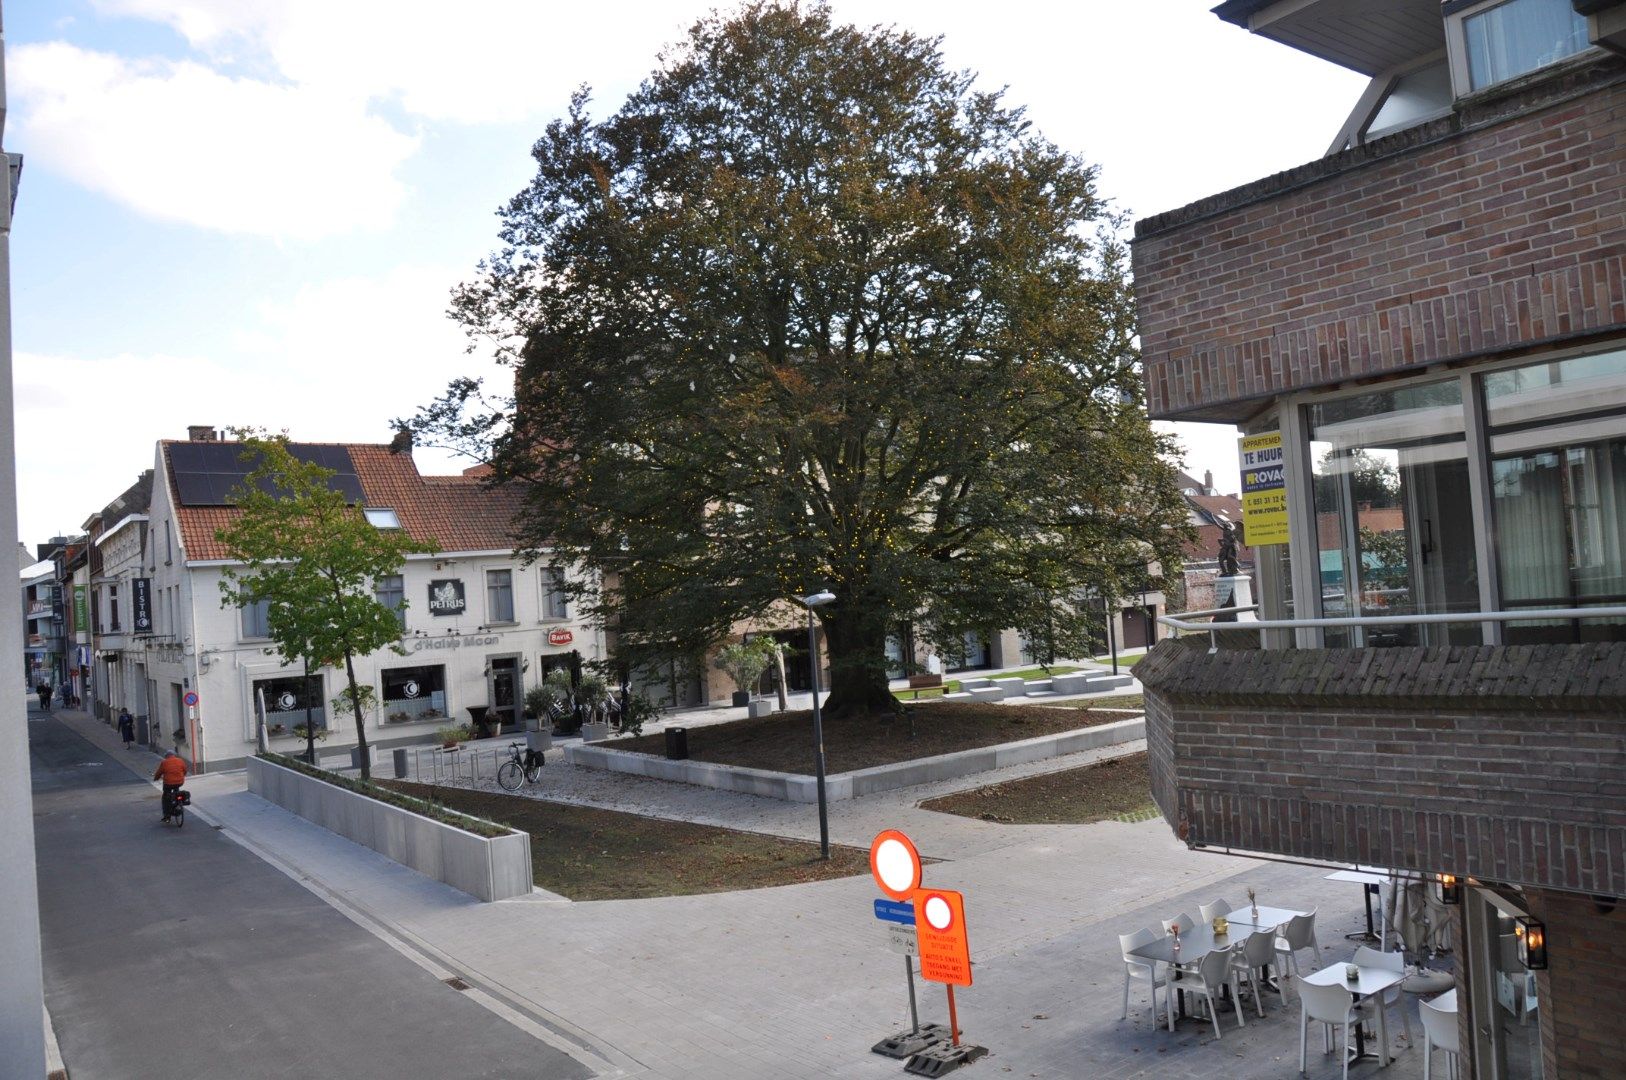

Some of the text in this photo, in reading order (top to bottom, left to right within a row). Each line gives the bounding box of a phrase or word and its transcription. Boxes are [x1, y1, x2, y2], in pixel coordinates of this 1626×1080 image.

[1244, 447, 1282, 464] TE HUUR
[430, 598, 464, 609] PETRUS
